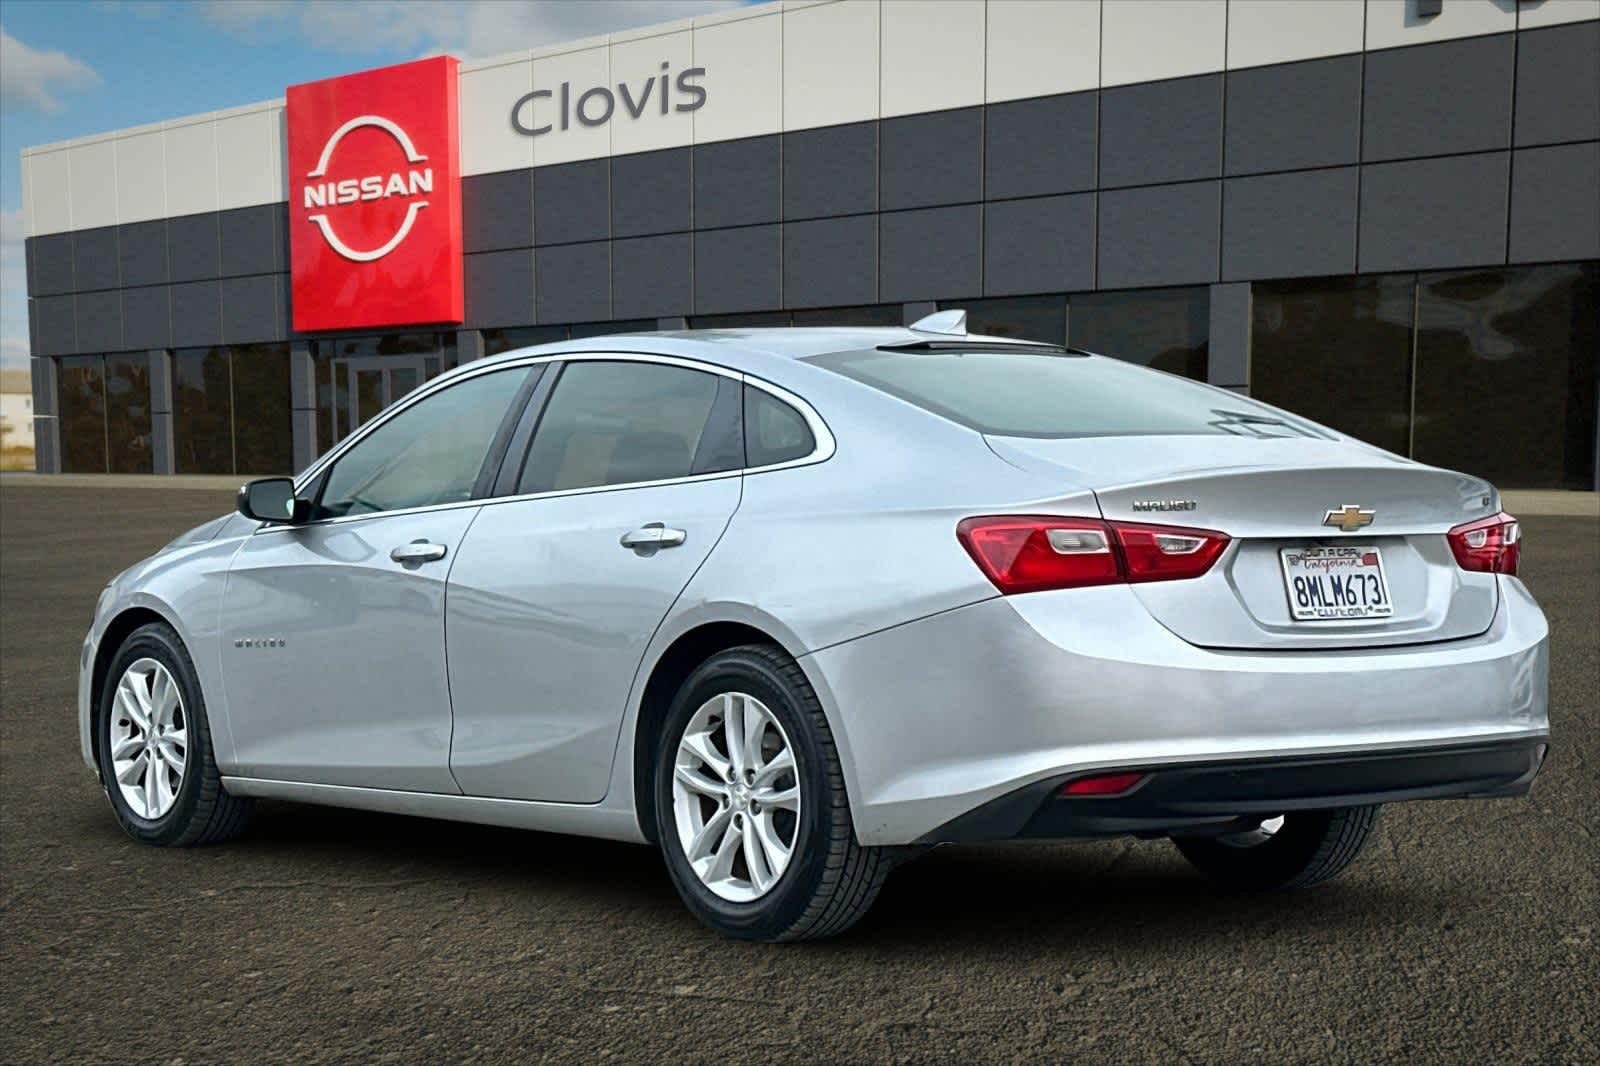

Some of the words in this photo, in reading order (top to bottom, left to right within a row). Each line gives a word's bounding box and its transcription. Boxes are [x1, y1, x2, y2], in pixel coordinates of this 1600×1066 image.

[510, 62, 706, 136] Clovis
[304, 168, 434, 208] NISSAN
[1304, 557, 1363, 573] California
[1294, 574, 1382, 607] 8MLM673
